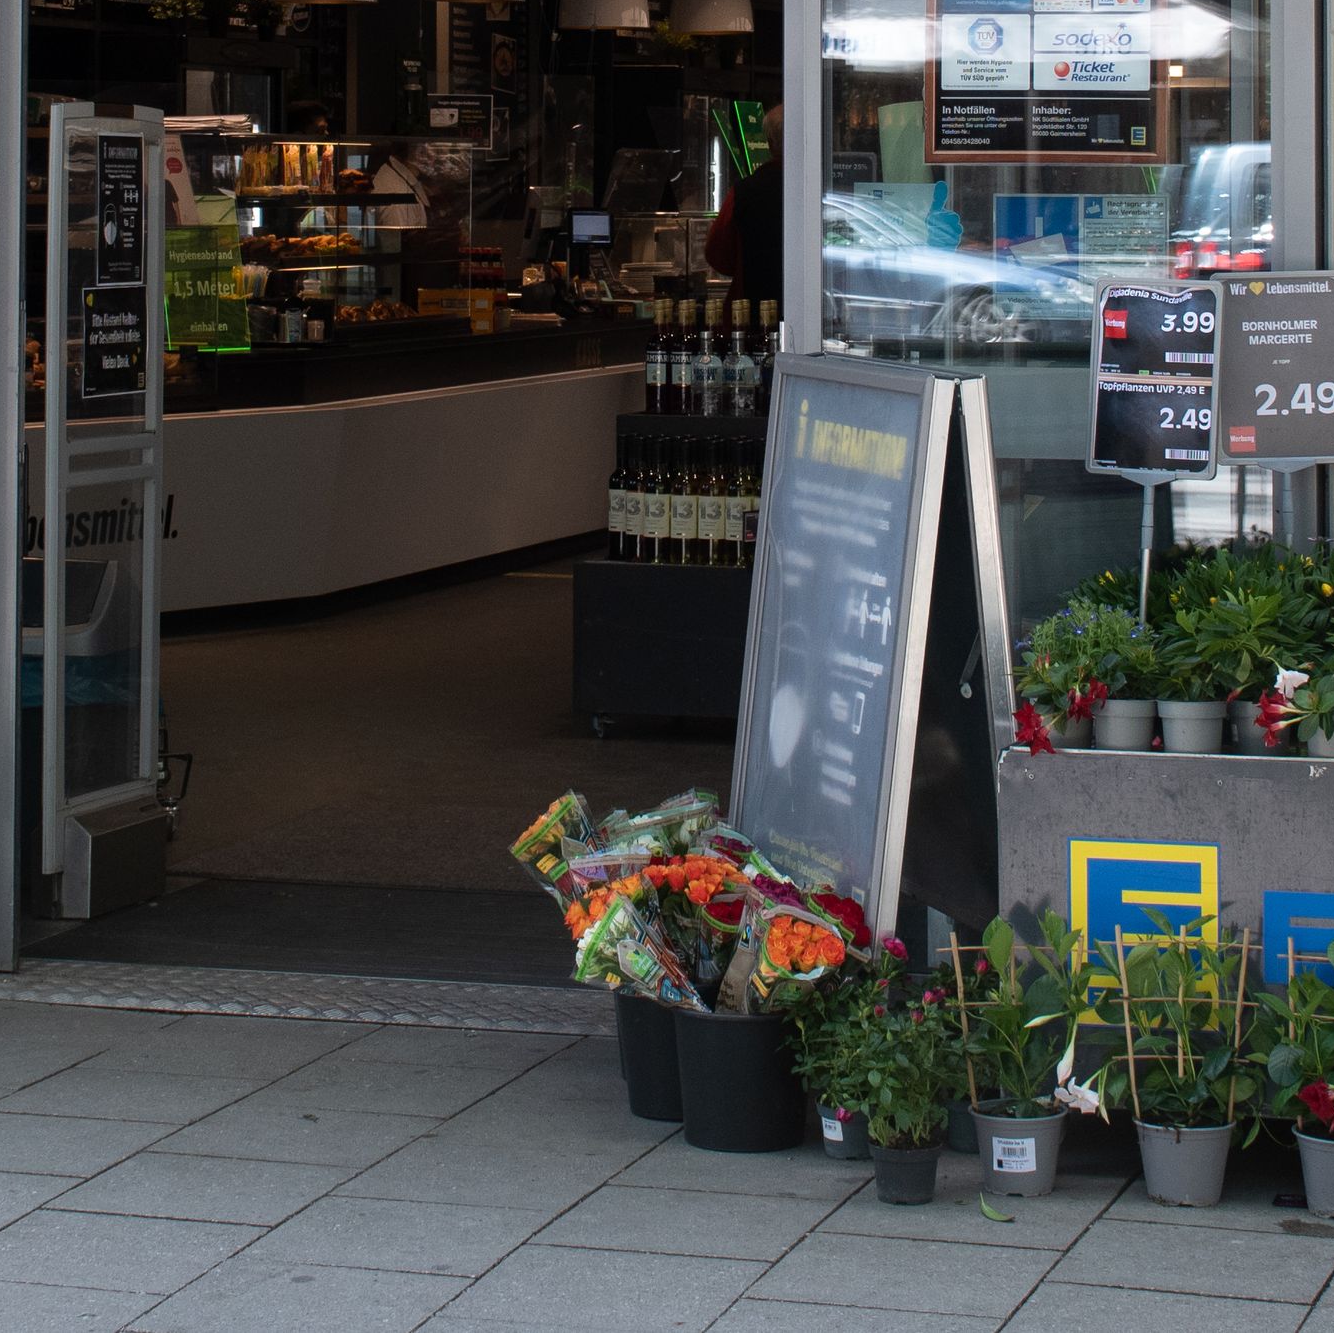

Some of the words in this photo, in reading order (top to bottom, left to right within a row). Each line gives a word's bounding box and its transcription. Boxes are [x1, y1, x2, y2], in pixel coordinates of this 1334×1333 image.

[1053, 29, 1131, 46] sodexo
[1072, 62, 1115, 73] Ticket
[943, 106, 951, 114] In
[954, 106, 995, 114] Notfällen
[1033, 106, 1071, 114] Inhaber:
[173, 281, 194, 298] 1,5
[197, 281, 236, 297] Meter
[1230, 283, 1247, 295] Wir
[1267, 281, 1332, 294] Lebensmittel.
[1105, 320, 1126, 329] Werbung
[1161, 312, 1215, 334] 3.99
[1242, 320, 1317, 332] BORNHOLMER
[1249, 334, 1312, 345] MARGERITE
[1099, 382, 1154, 393] Topfpflanzen
[1157, 385, 1174, 394] UVP
[1177, 385, 1197, 395] 2,49
[1160, 408, 1211, 430] 2.49
[1230, 434, 1255, 443] Werbung
